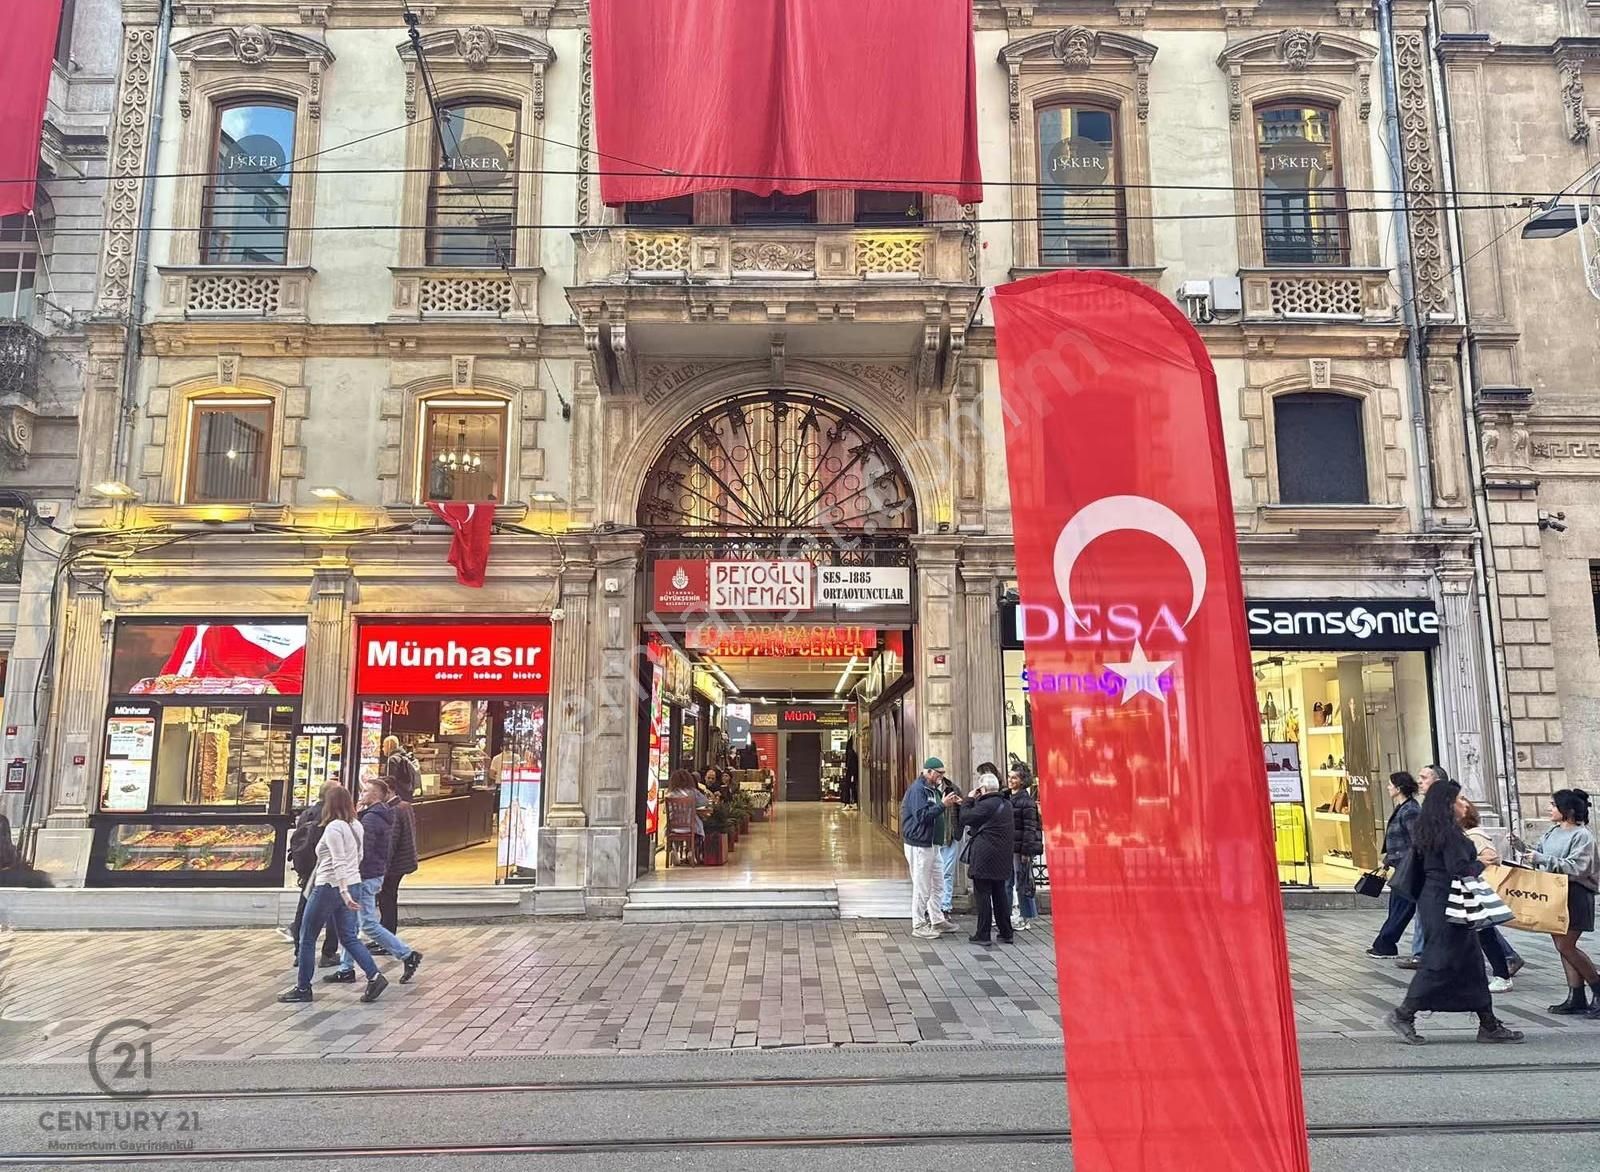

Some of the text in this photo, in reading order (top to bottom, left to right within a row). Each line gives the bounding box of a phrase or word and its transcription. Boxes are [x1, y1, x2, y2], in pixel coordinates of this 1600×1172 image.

[716, 562, 805, 585] BEYOĞLU
[823, 587, 905, 600] ORTAOYUNCULAR
[1016, 603, 1188, 643] DESA
[1248, 606, 1439, 639] Samsonite
[367, 640, 542, 667] Münhasır
[1348, 775, 1370, 786] DESA
